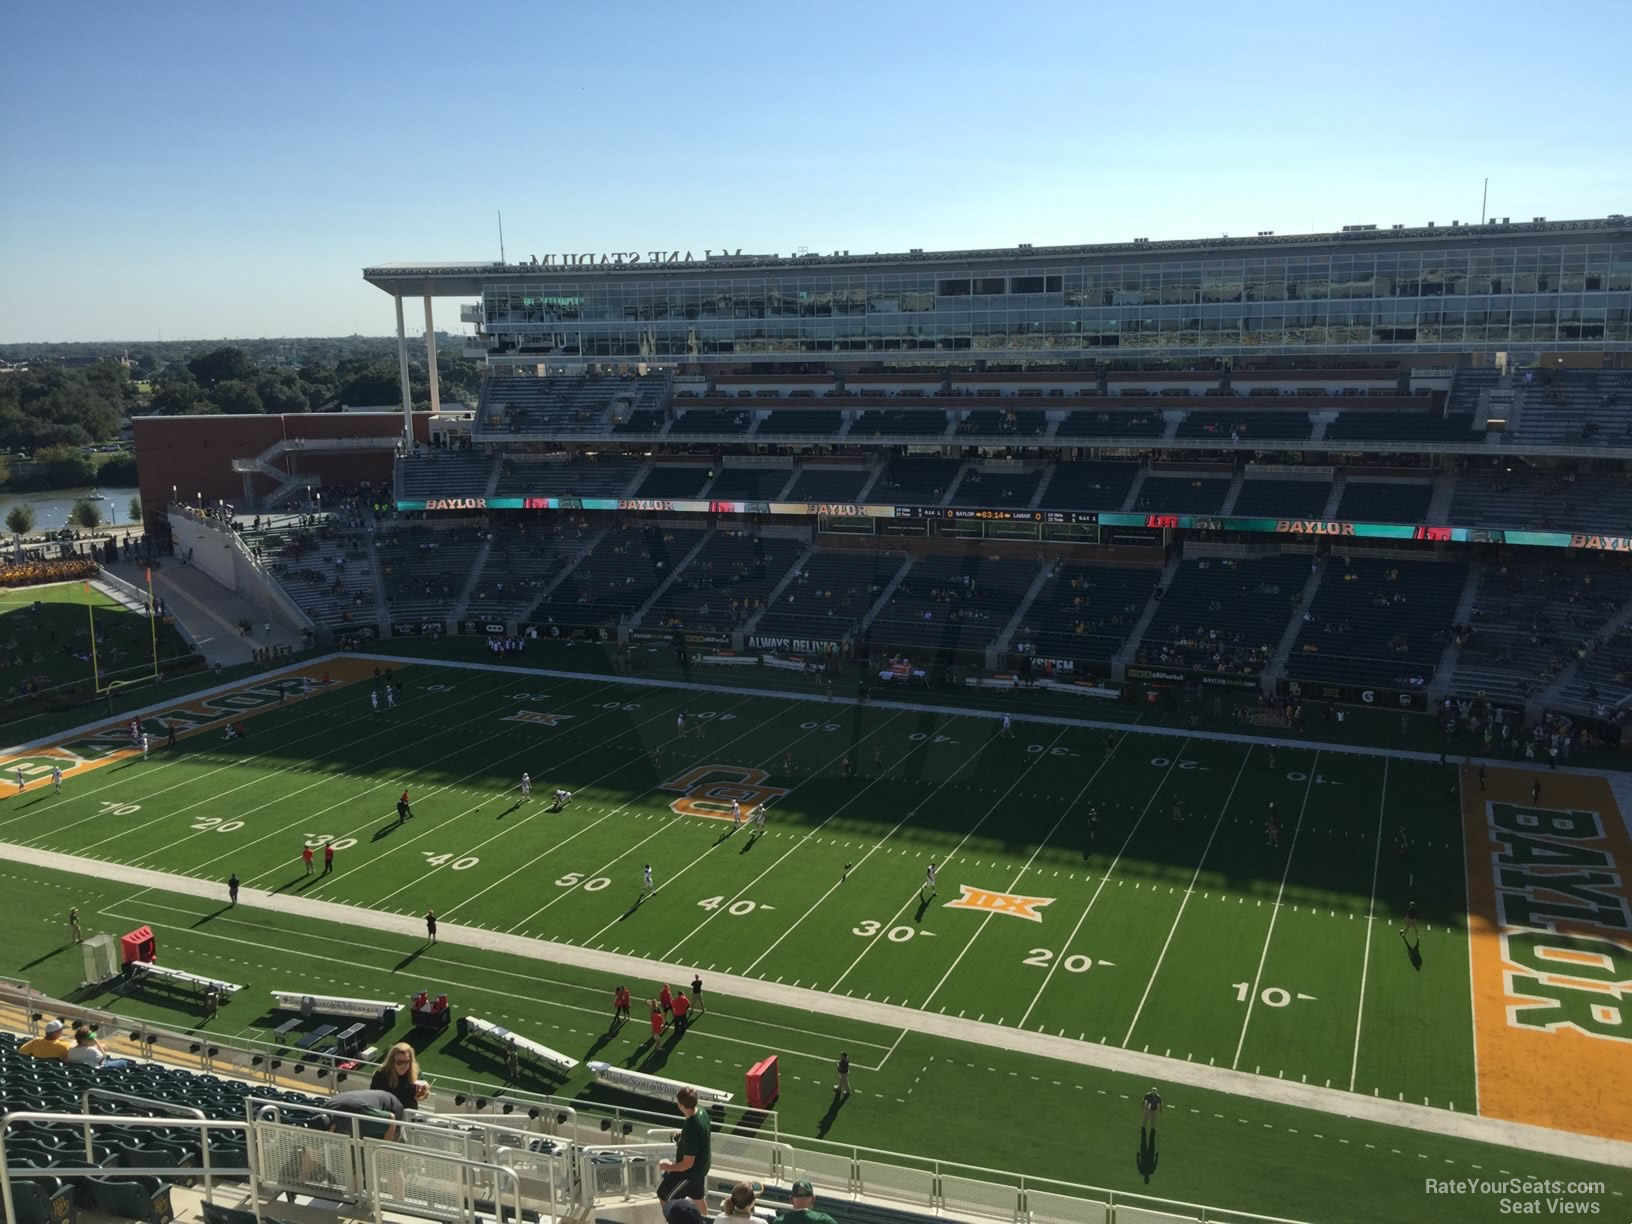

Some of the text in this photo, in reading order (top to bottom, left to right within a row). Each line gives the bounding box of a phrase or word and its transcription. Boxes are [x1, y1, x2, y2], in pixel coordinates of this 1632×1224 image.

[424, 498, 487, 511] BAYLOR
[617, 499, 674, 511] BAYLOR
[807, 504, 868, 516] BAYLOR
[947, 510, 953, 518] 0
[1035, 513, 1042, 521] 0
[1276, 520, 1355, 536] BAYLOR
[749, 636, 790, 649] ALWAYS
[1289, 682, 1302, 696] BU
[1361, 690, 1374, 703] G
[697, 711, 737, 721] 40
[800, 721, 841, 733] 50
[908, 732, 951, 744] 40
[1027, 744, 1071, 756] 30
[1151, 757, 1199, 769] 20
[107, 801, 141, 816] 10
[191, 817, 245, 832] 20
[304, 834, 358, 850] 30
[426, 853, 480, 870] 40
[555, 872, 611, 891] 50
[697, 895, 756, 915] 40
[1485, 800, 1632, 1043] BAYLOR
[852, 920, 915, 942] 30
[1022, 948, 1092, 973] 20
[1232, 982, 1291, 1007] 10
